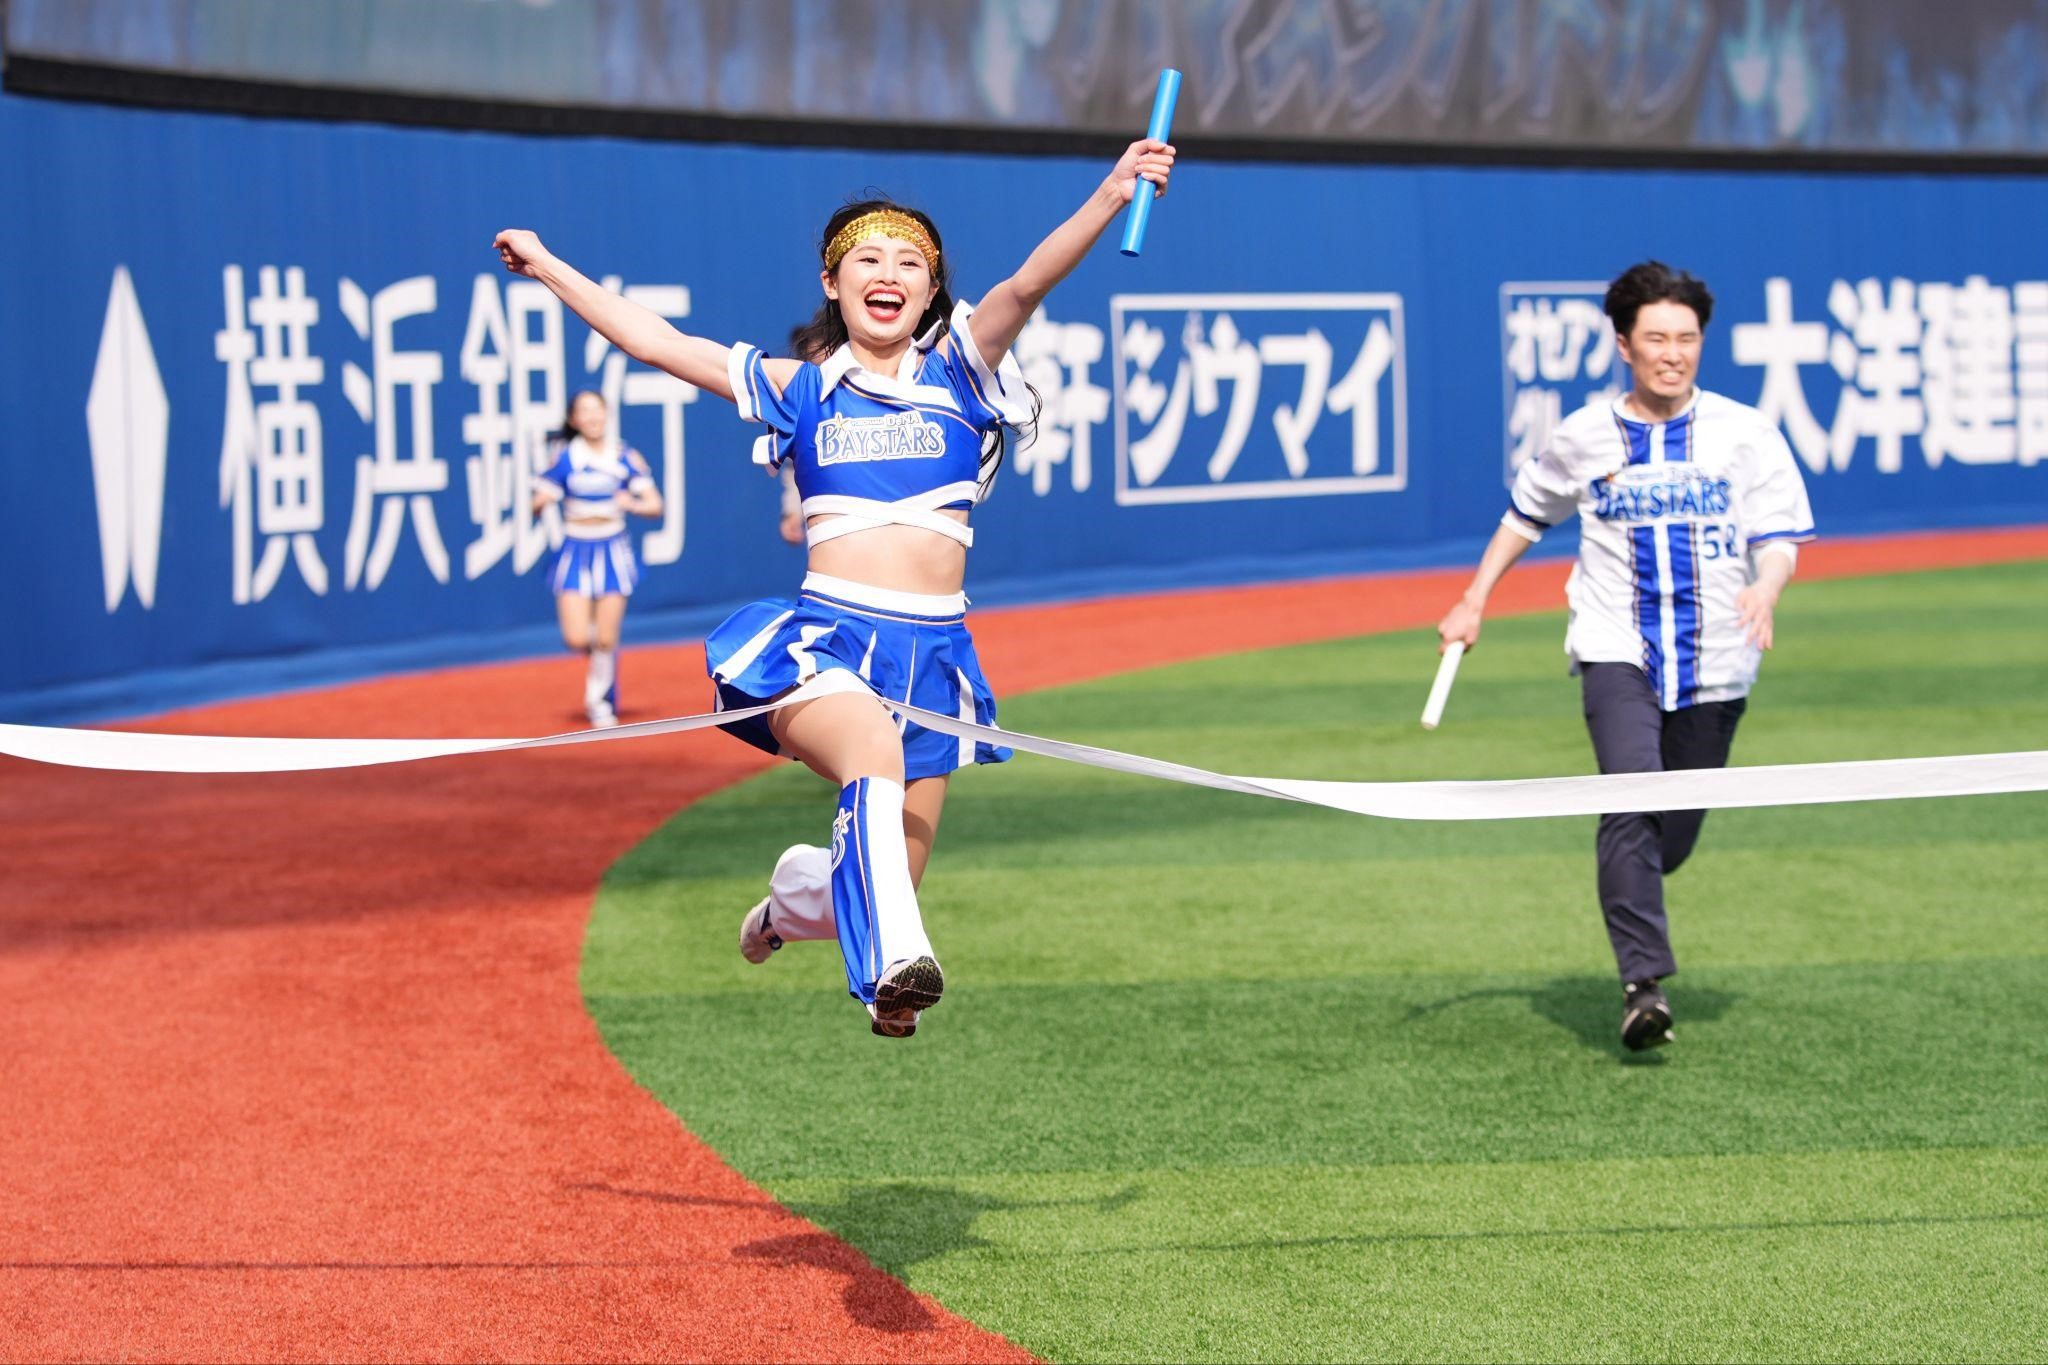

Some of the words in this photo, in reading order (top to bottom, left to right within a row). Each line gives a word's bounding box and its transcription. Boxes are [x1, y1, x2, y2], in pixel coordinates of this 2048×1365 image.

[886, 413, 921, 427] DeNA
[980, 303, 1111, 497] 軒
[215, 264, 698, 604] 横浜銀行
[821, 422, 941, 462] BAYSTARS
[1589, 478, 1731, 521] BAYSTARS
